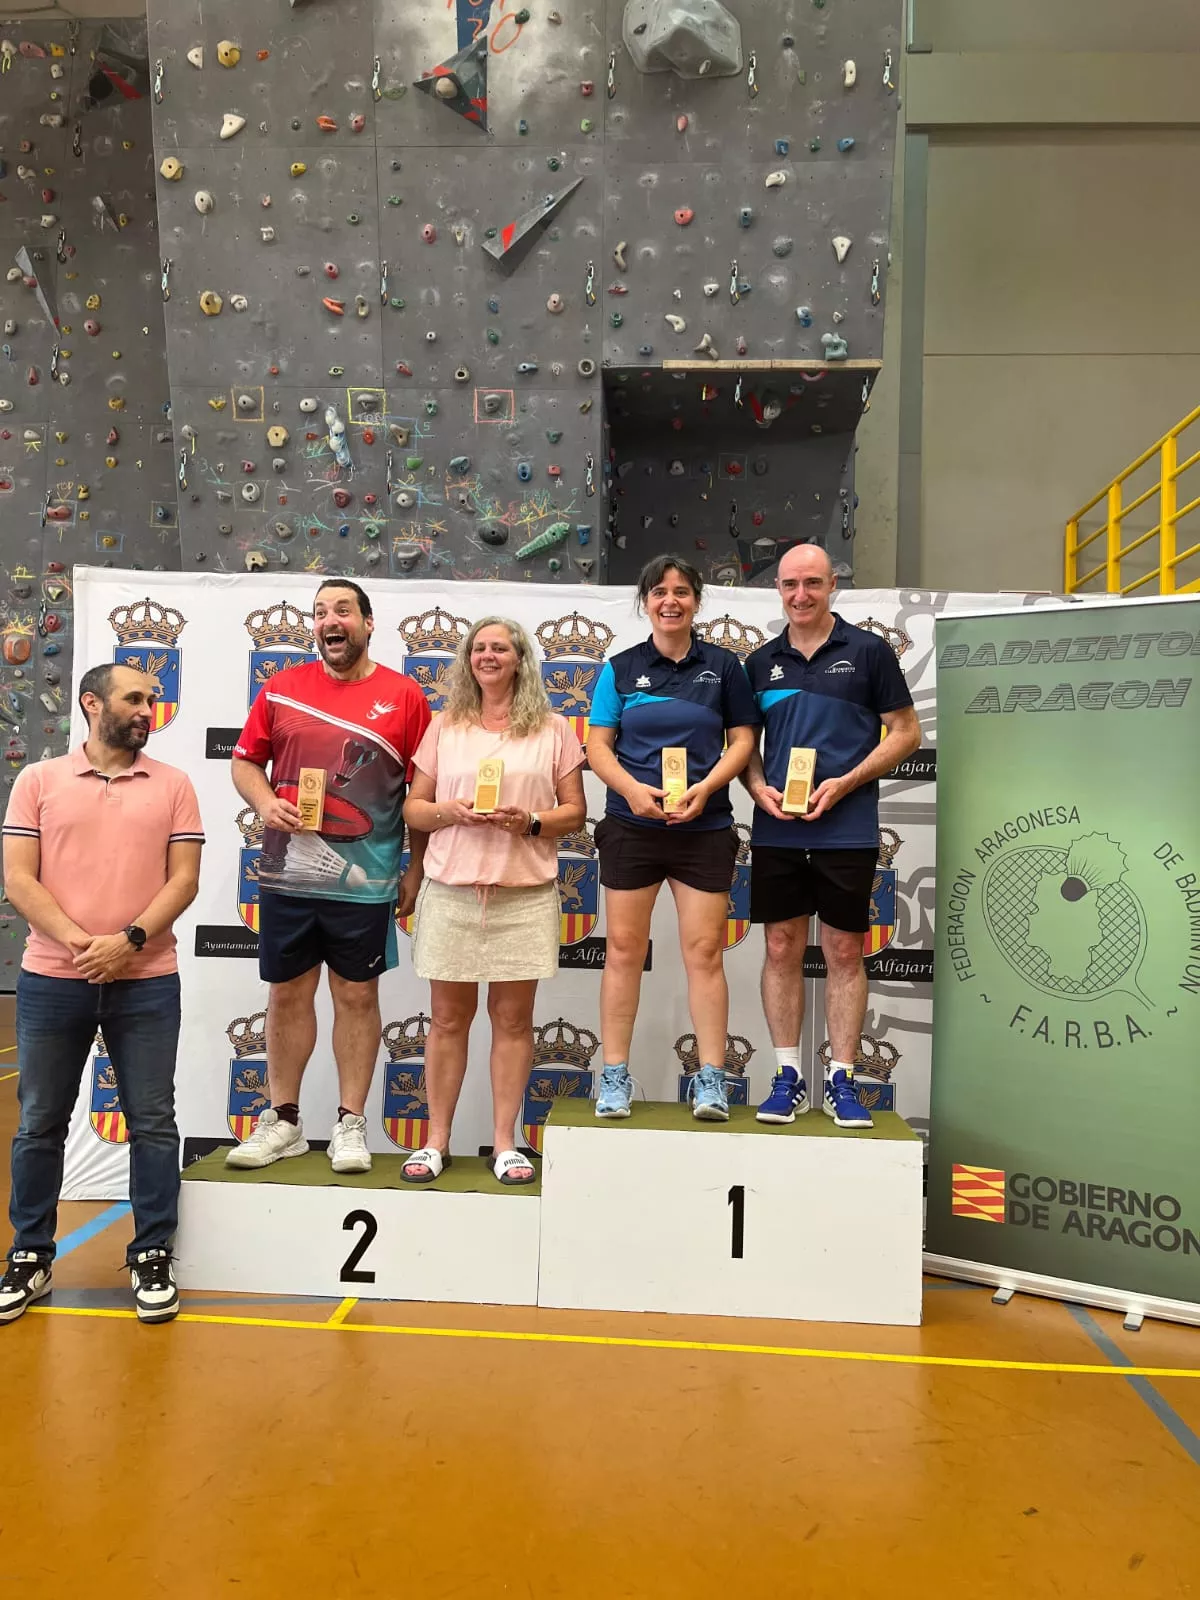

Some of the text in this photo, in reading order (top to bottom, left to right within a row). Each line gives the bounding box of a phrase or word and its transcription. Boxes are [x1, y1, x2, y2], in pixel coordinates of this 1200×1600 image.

[964, 678, 1192, 714] ARAGON
[947, 868, 977, 982] FEDERACION
[974, 805, 1081, 864] ARAGONESA
[1153, 841, 1184, 871] DE
[201, 941, 260, 952] Ayuntamient
[571, 946, 605, 965] Alfa
[728, 1185, 745, 1259] 1
[1009, 1172, 1181, 1222] GOBIERNO
[340, 1209, 378, 1284] 2
[1009, 1201, 1200, 1257] DE ARAGON
